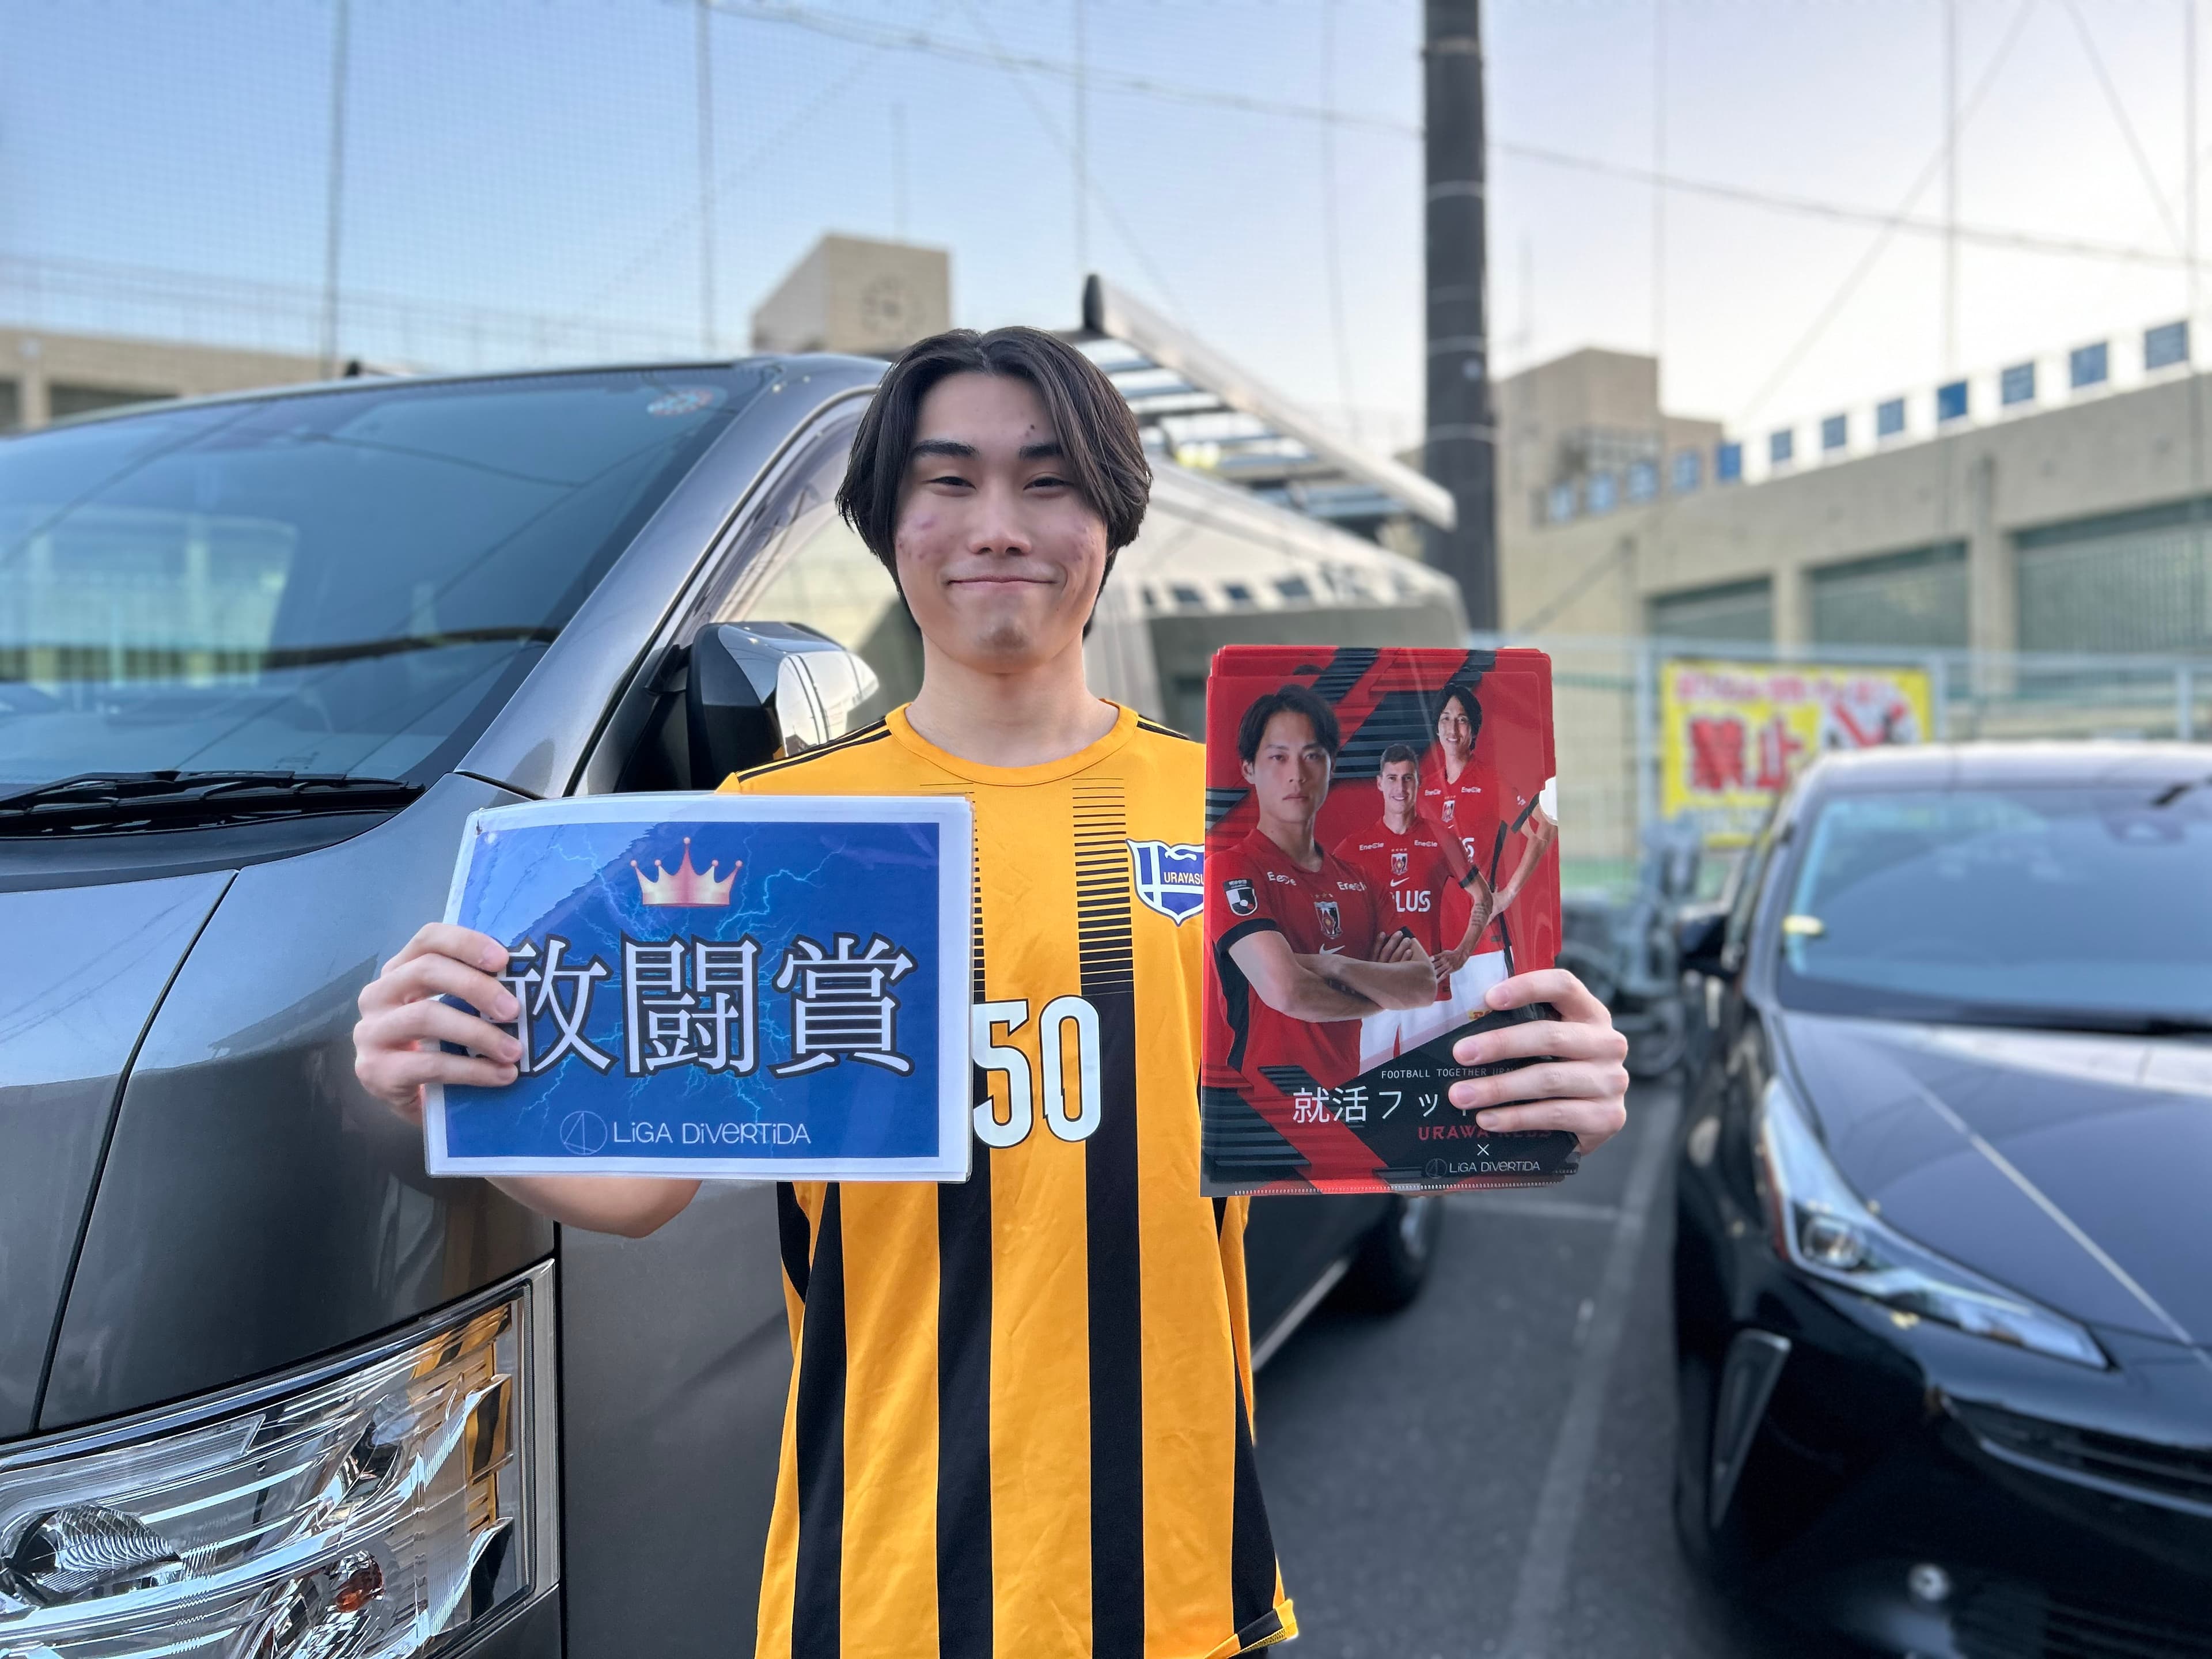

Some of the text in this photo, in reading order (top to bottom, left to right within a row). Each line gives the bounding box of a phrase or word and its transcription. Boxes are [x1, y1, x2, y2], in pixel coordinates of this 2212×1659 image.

[972, 995, 1101, 1149] 50
[1381, 1069, 1430, 1079] FOOTBALL
[1436, 1068, 1487, 1077] TOGETHER
[1293, 1085, 1466, 1123] 就活フッ
